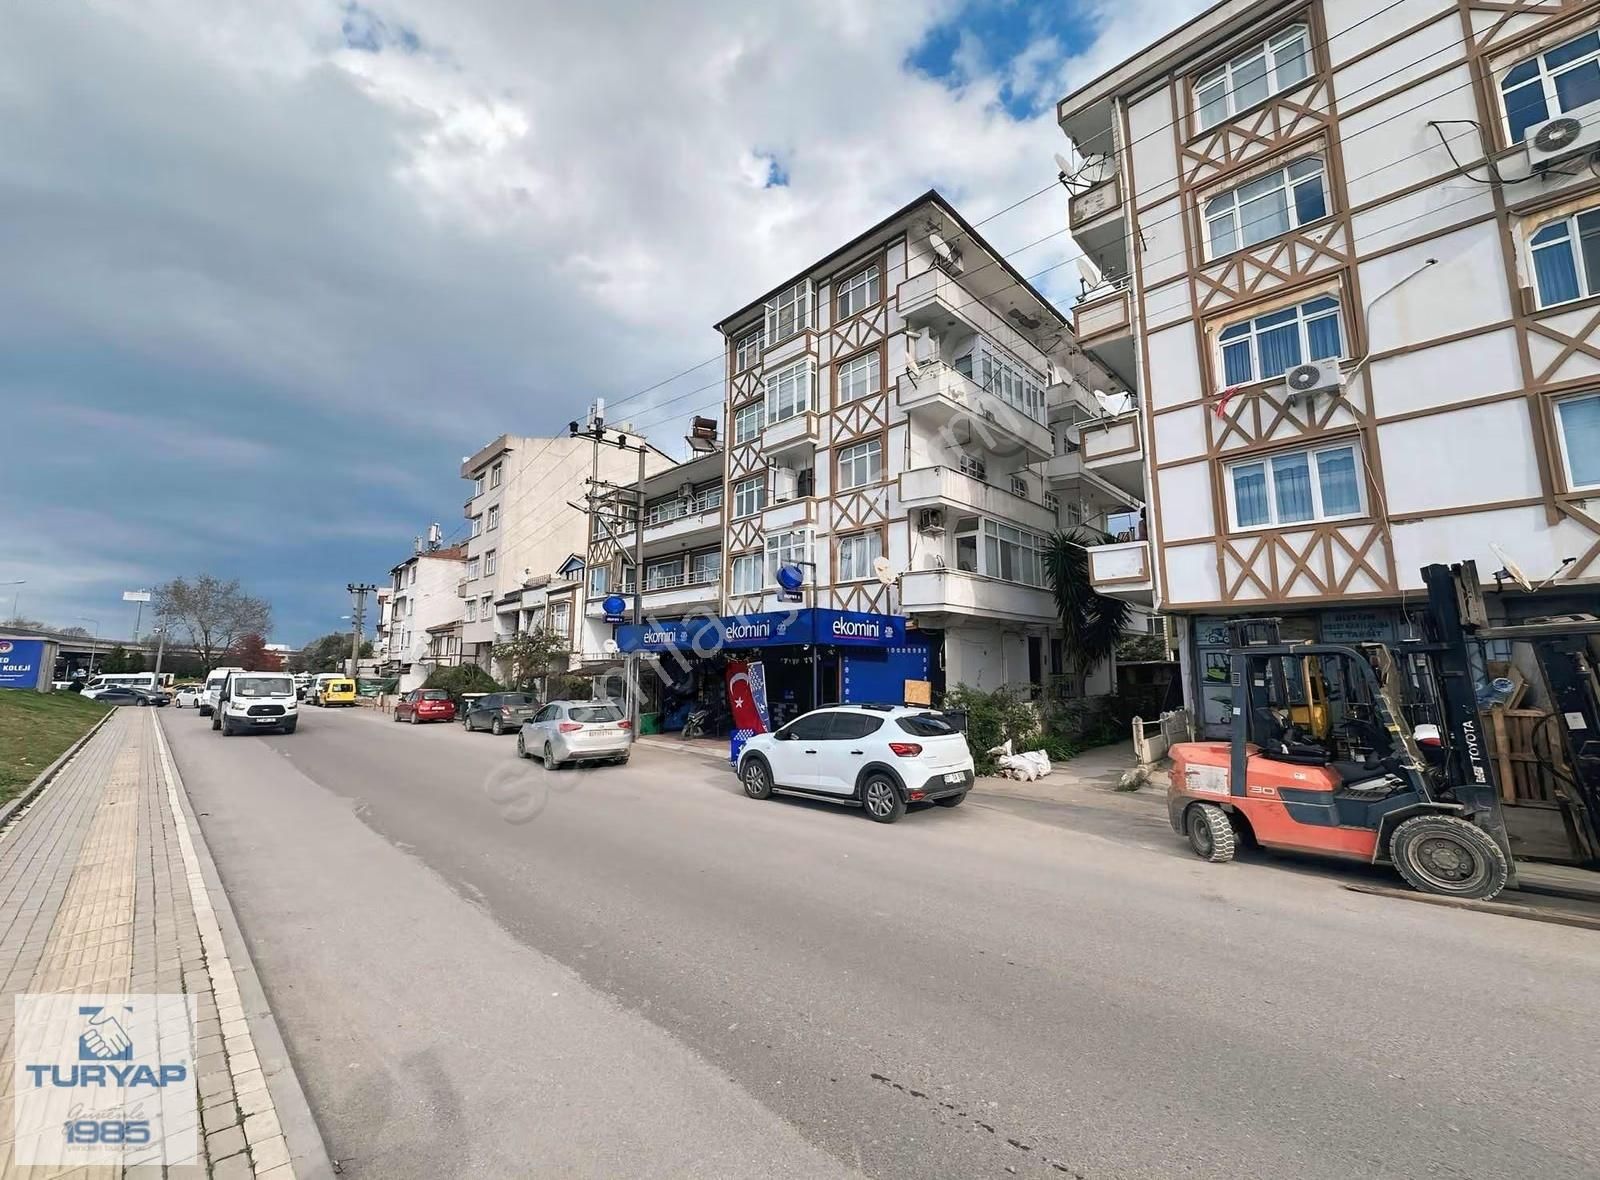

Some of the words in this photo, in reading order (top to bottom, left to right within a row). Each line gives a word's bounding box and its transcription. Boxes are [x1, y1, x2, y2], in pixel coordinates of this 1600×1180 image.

[643, 627, 676, 643] ekomini
[726, 619, 770, 639] ekomini
[833, 616, 880, 637] ekomini
[1462, 720, 1481, 765] TOYOTA
